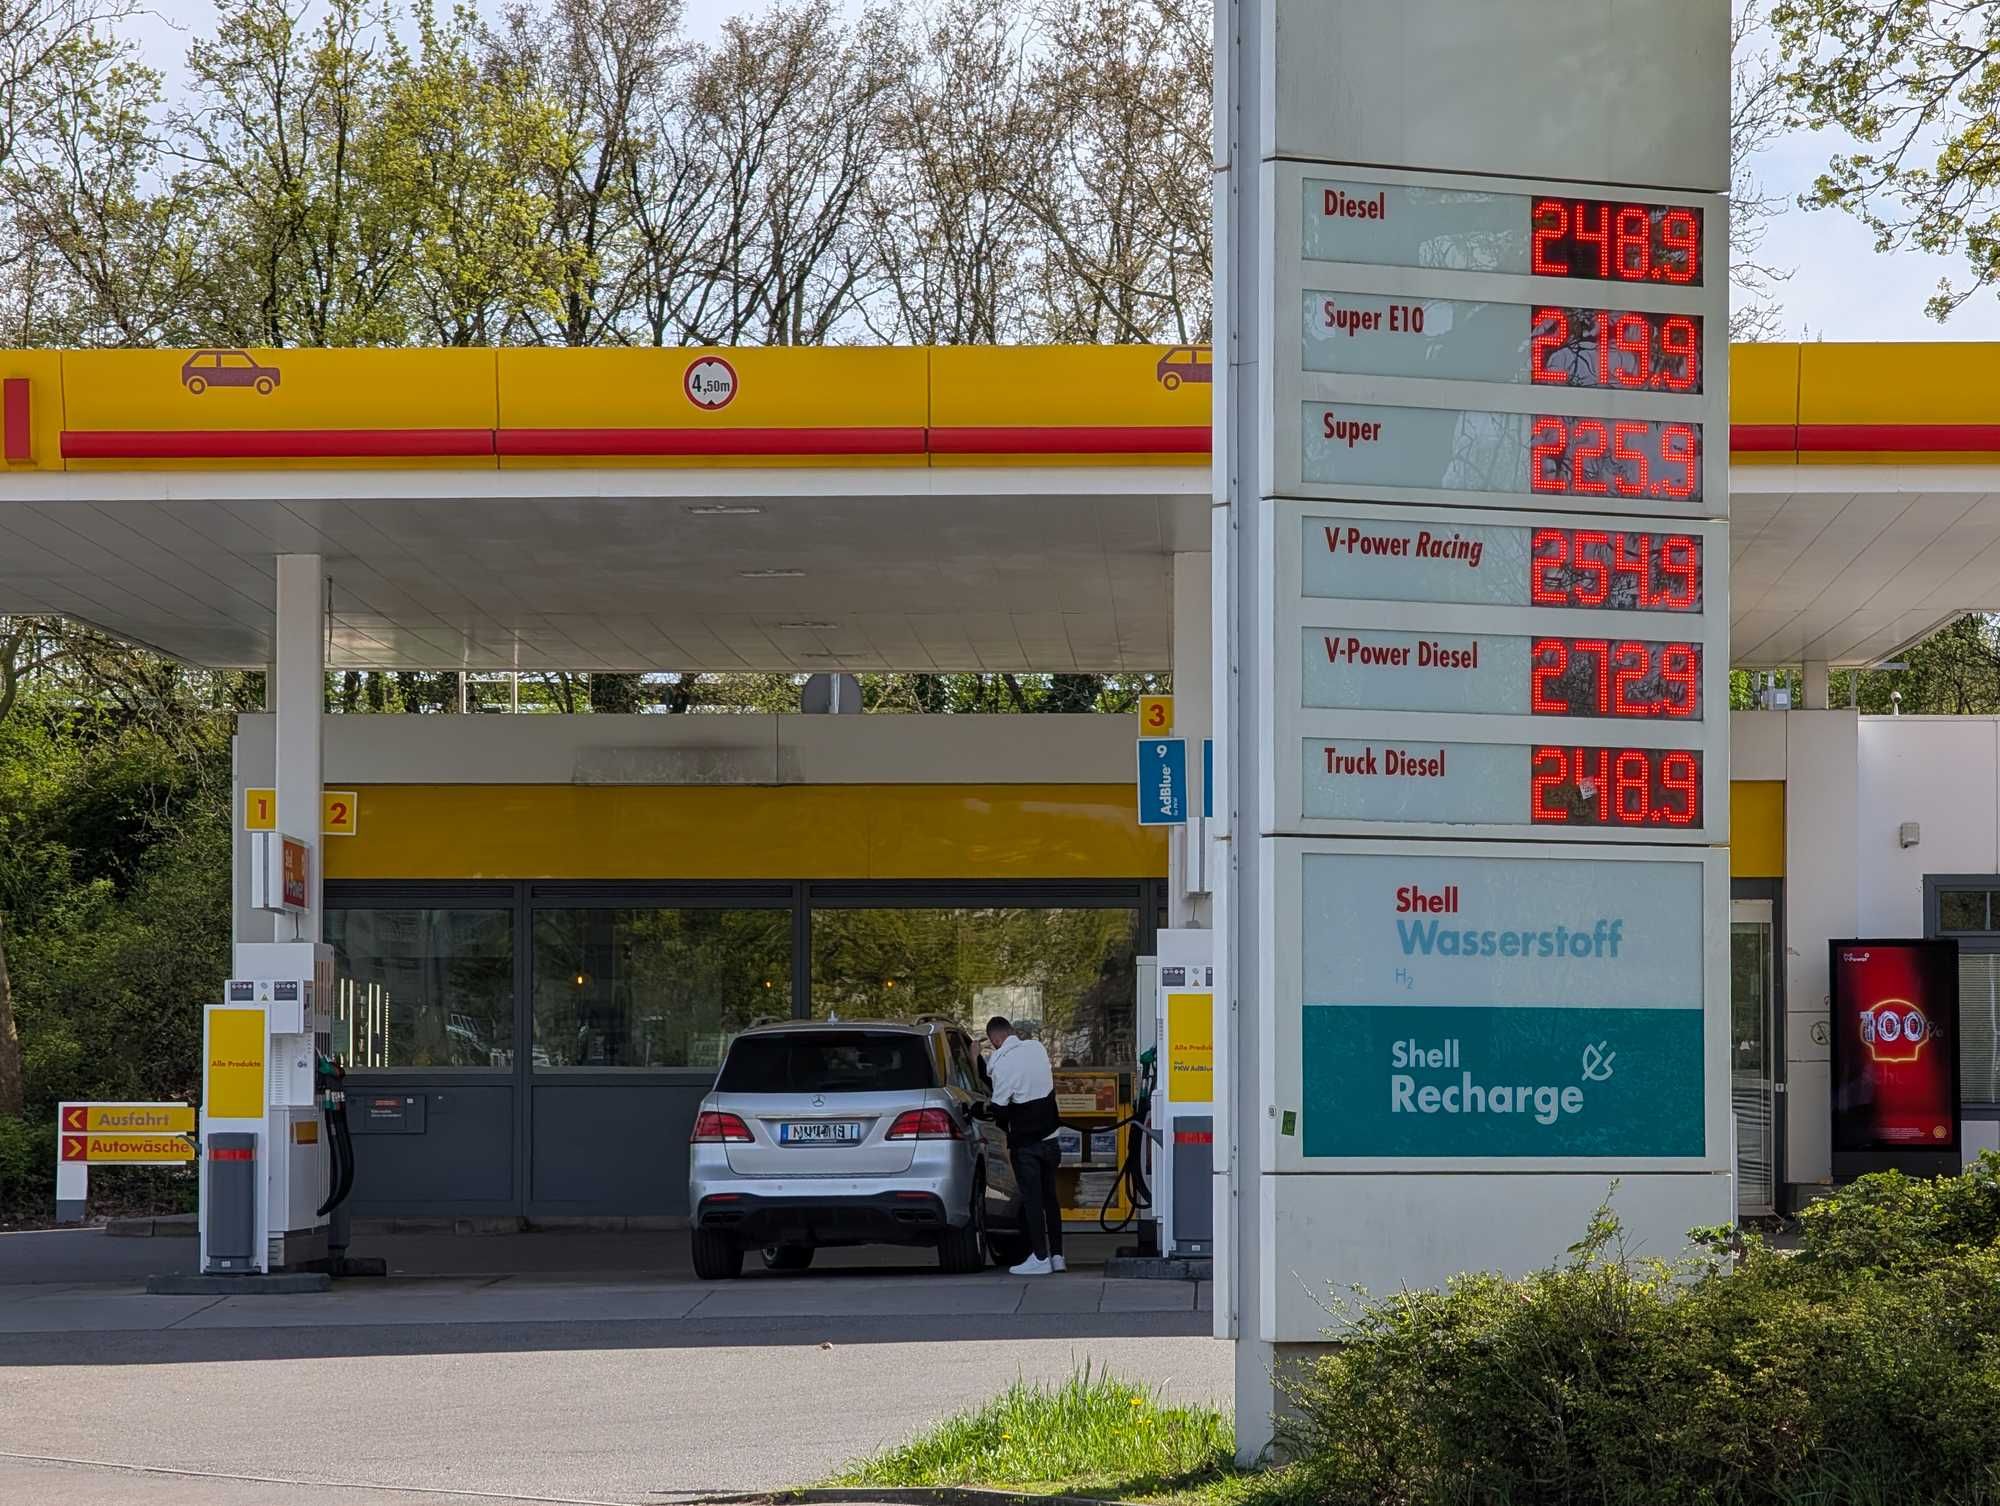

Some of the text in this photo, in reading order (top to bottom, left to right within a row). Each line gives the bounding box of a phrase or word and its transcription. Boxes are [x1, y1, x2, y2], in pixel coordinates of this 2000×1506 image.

[1324, 189, 1385, 220] Diesel
[1533, 200, 1697, 282] 248.9
[1324, 301, 1424, 336] Super E10
[1532, 309, 1697, 390] 219.9
[692, 374, 730, 396] 4,50m
[1324, 412, 1381, 448] Super
[1532, 416, 1696, 498] 225.9
[1325, 527, 1483, 567] V-Power Racing
[1532, 528, 1697, 610] 254.9
[1325, 637, 1478, 669] V-Power Diesel
[1532, 639, 1697, 717] 272.9
[1148, 704, 1165, 727] 3
[1156, 744, 1168, 758] 9
[1325, 747, 1445, 778] Truck Diesel
[1533, 748, 1697, 824] 248.9
[258, 799, 267, 819] 1
[330, 803, 347, 824] 2
[1396, 886, 1458, 913] Shell
[1396, 918, 1625, 958] Wasserstoff
[1391, 1038, 1460, 1068] Shell
[1391, 1071, 1584, 1125] Recharge
[98, 1112, 169, 1126] Ausfahrt
[90, 1139, 190, 1153] Autowäsche
